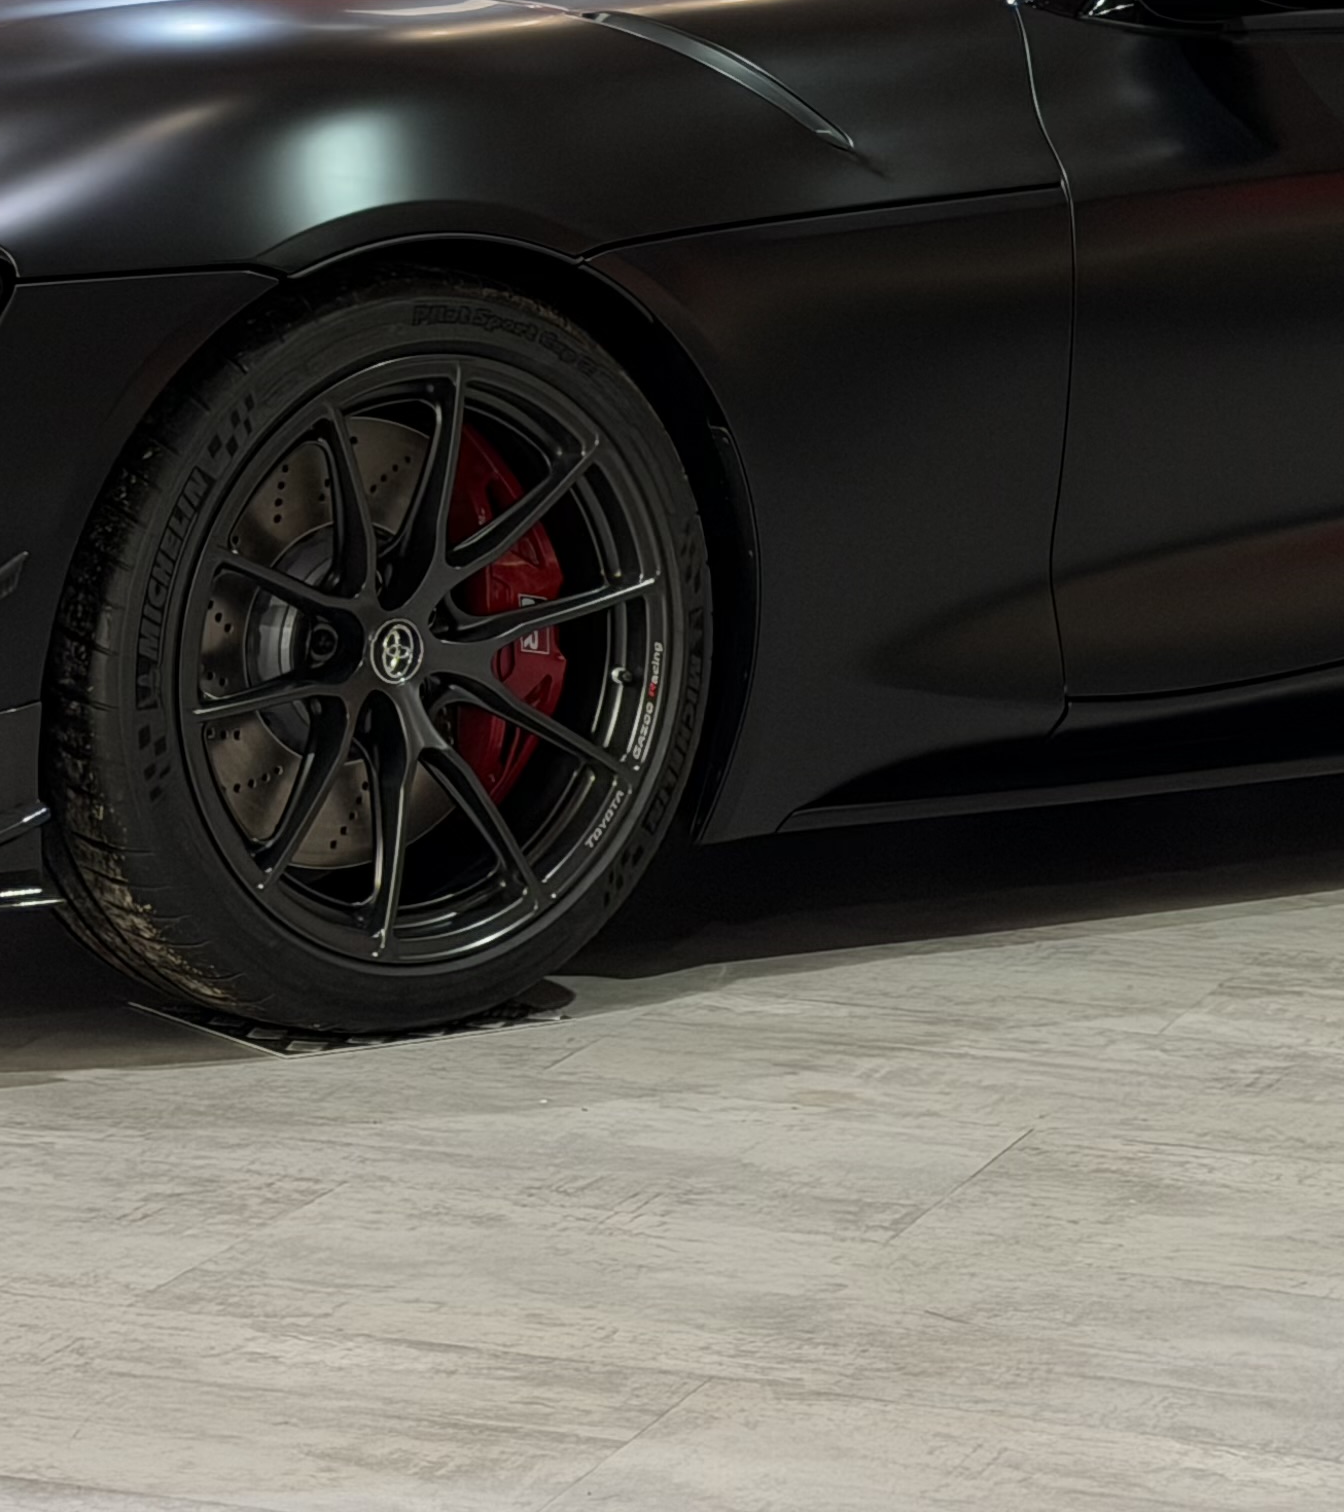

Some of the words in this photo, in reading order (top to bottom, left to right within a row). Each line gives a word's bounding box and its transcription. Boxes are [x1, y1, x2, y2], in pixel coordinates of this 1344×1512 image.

[137, 466, 215, 662] MICHELIN
[632, 701, 654, 760] GAZOO
[584, 789, 624, 849] TOYOTA
